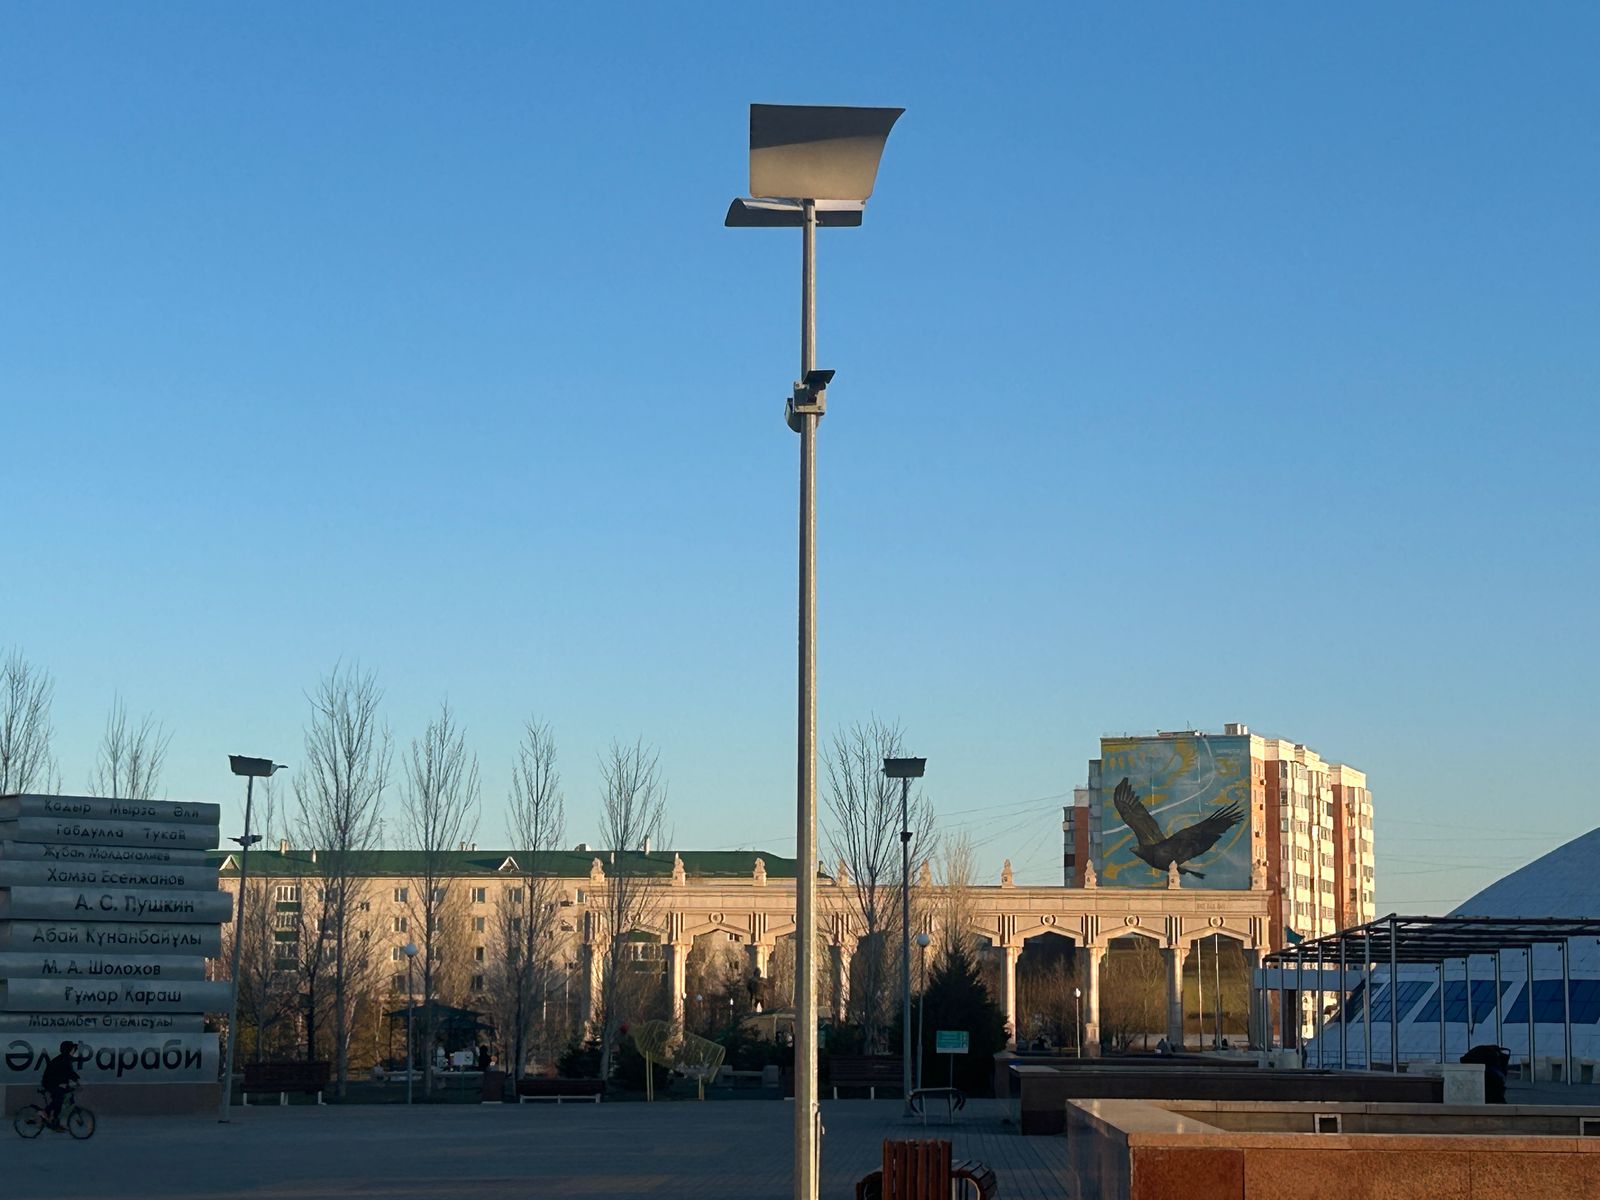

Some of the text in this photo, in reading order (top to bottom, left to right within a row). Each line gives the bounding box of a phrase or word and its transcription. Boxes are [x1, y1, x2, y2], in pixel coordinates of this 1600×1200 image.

[48, 868, 185, 885] Хамза Есенжанов
[75, 893, 195, 917] А. С. Пушкин
[33, 927, 79, 943] Абай
[42, 959, 161, 975] М. А. Шолохов
[28, 1015, 98, 1027] Махамбет
